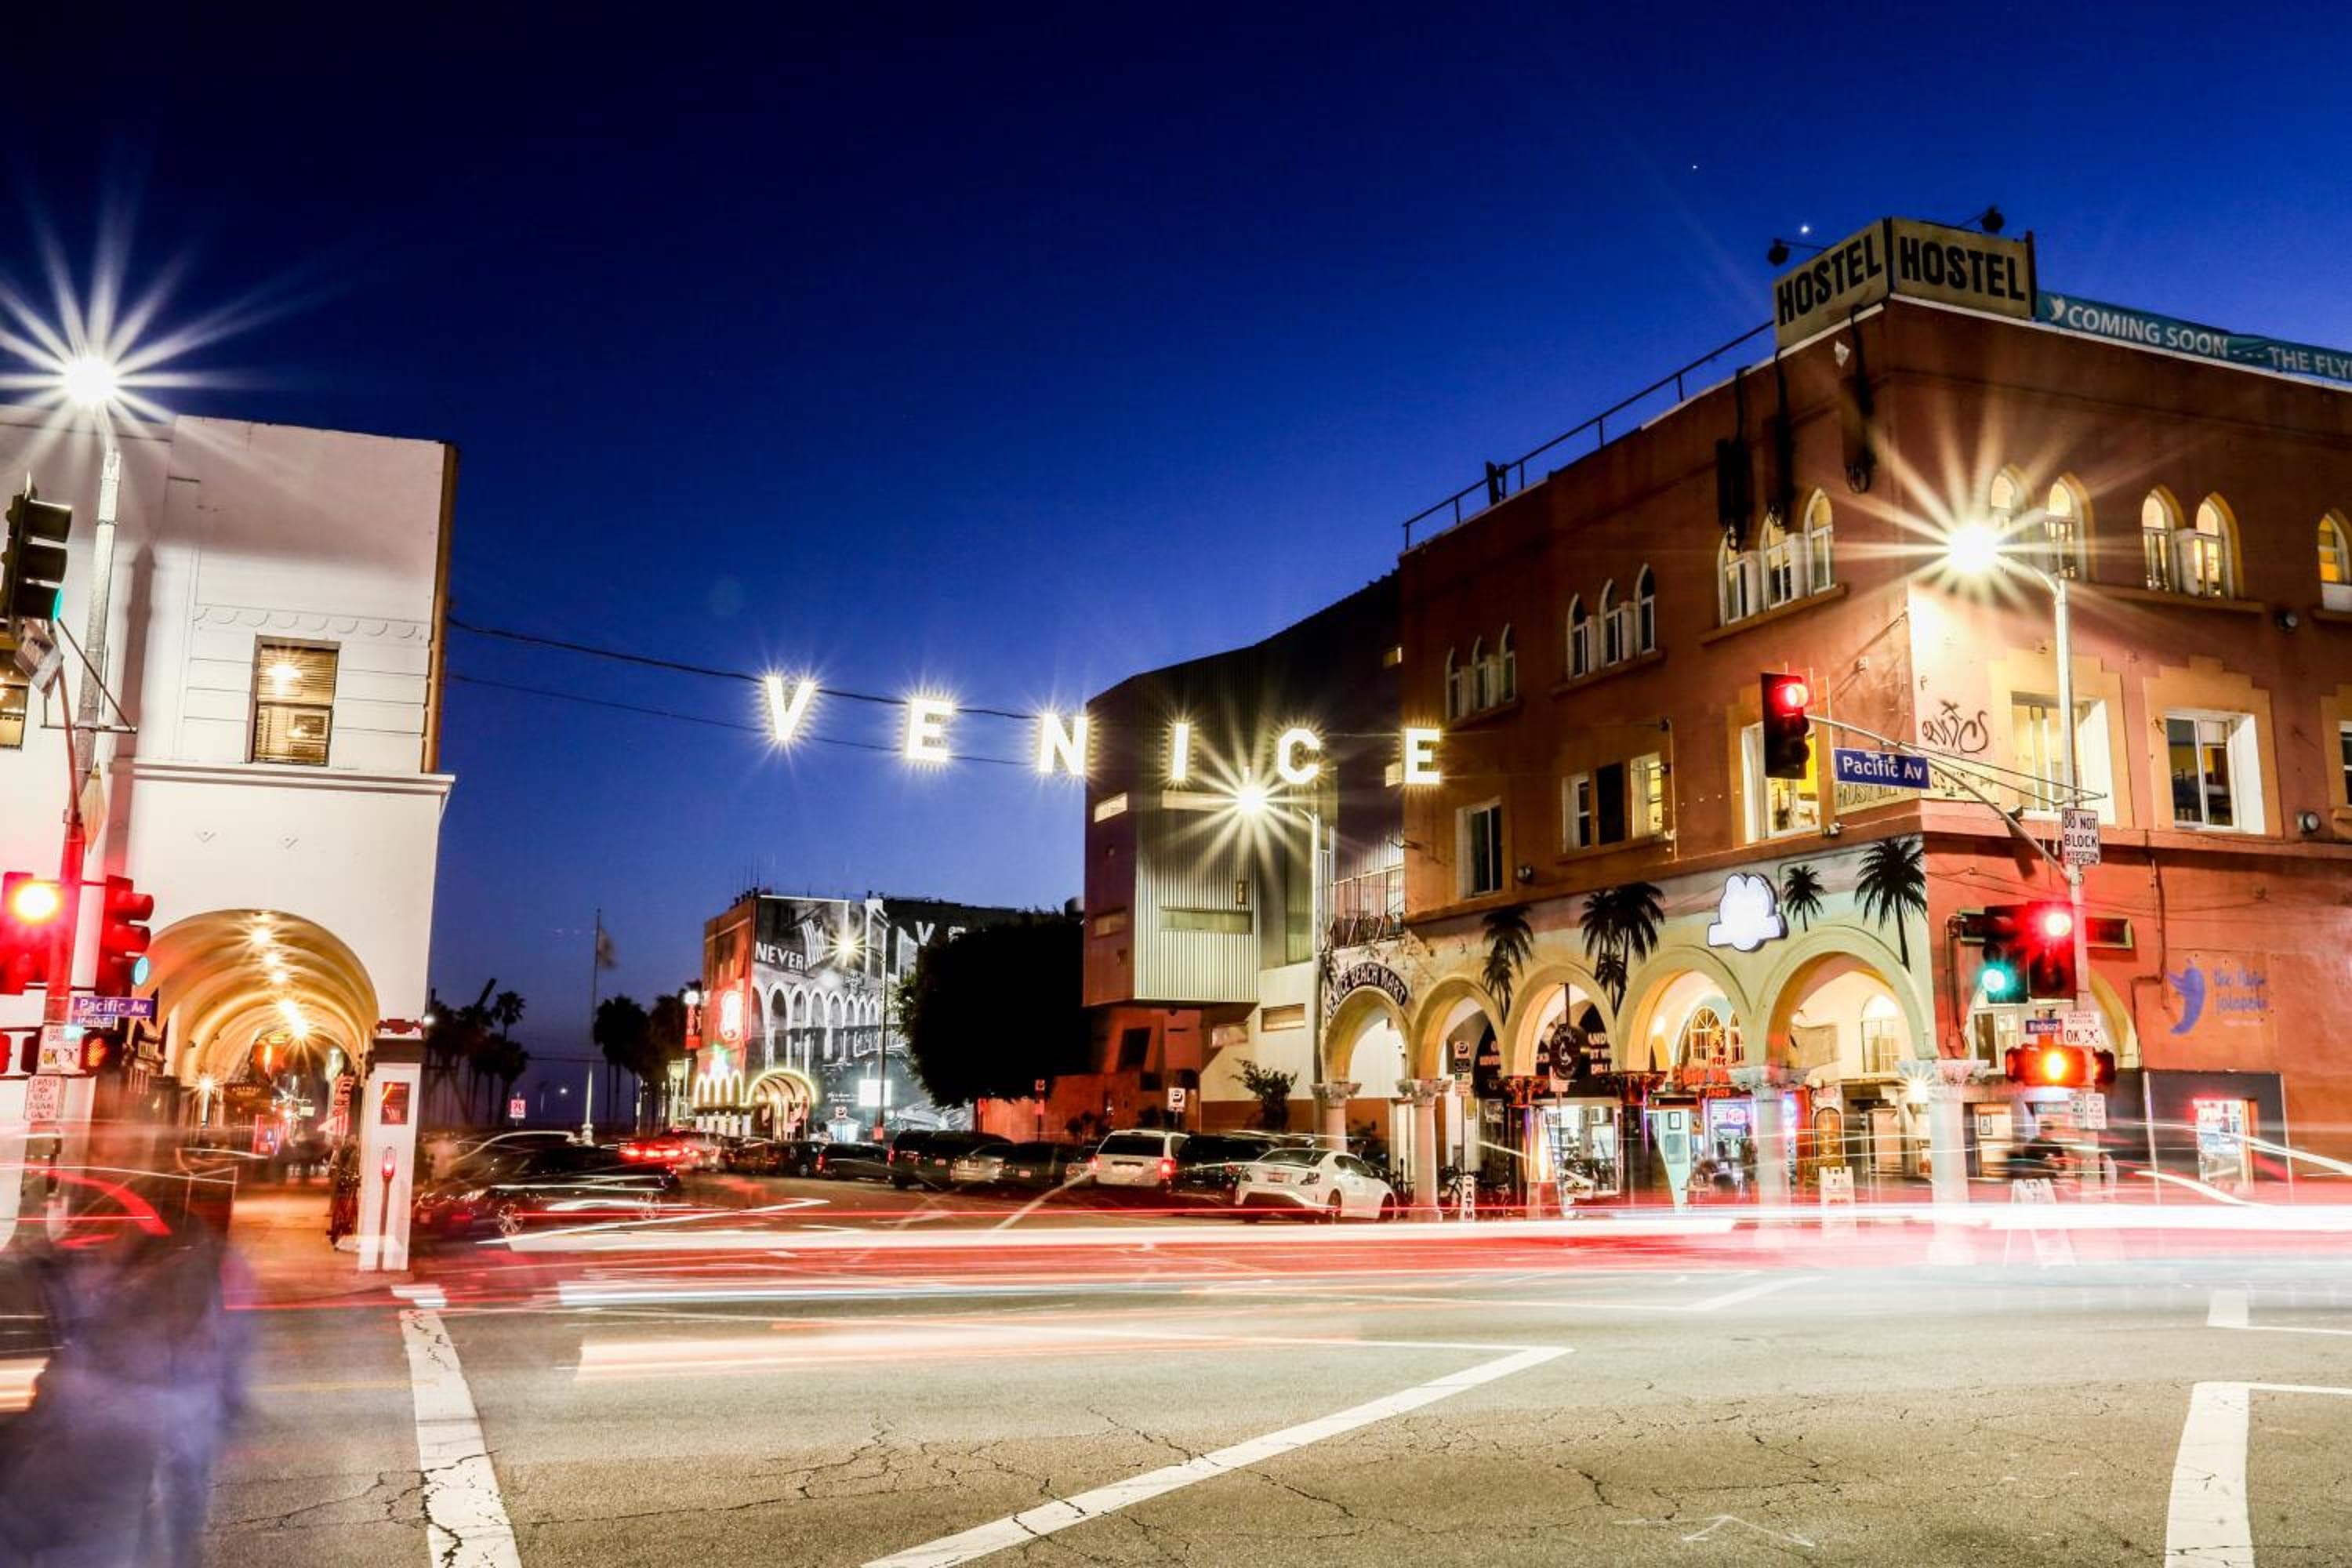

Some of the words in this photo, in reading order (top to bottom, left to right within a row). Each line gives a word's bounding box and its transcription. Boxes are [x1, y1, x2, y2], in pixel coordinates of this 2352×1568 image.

[1777, 233, 1882, 326] HOSTEL
[1900, 236, 2025, 302] HOSTEL
[2068, 307, 2160, 344] COMING
[2166, 326, 2228, 358] SOON
[2267, 346, 2308, 371] THE
[764, 676, 1441, 785] VENICE
[1843, 756, 1899, 779] Pacific
[1904, 761, 1922, 780] Av
[2080, 818, 2096, 830] NOT
[2064, 833, 2097, 848] BLOCK
[755, 941, 804, 970] NEVER
[1349, 964, 1378, 987] BEACH
[1381, 968, 1406, 1004] MART
[79, 998, 127, 1014] Pacific
[131, 1000, 147, 1014] Av
[2066, 1029, 2080, 1042] OK
[1465, 1192, 1473, 1219] ATM
